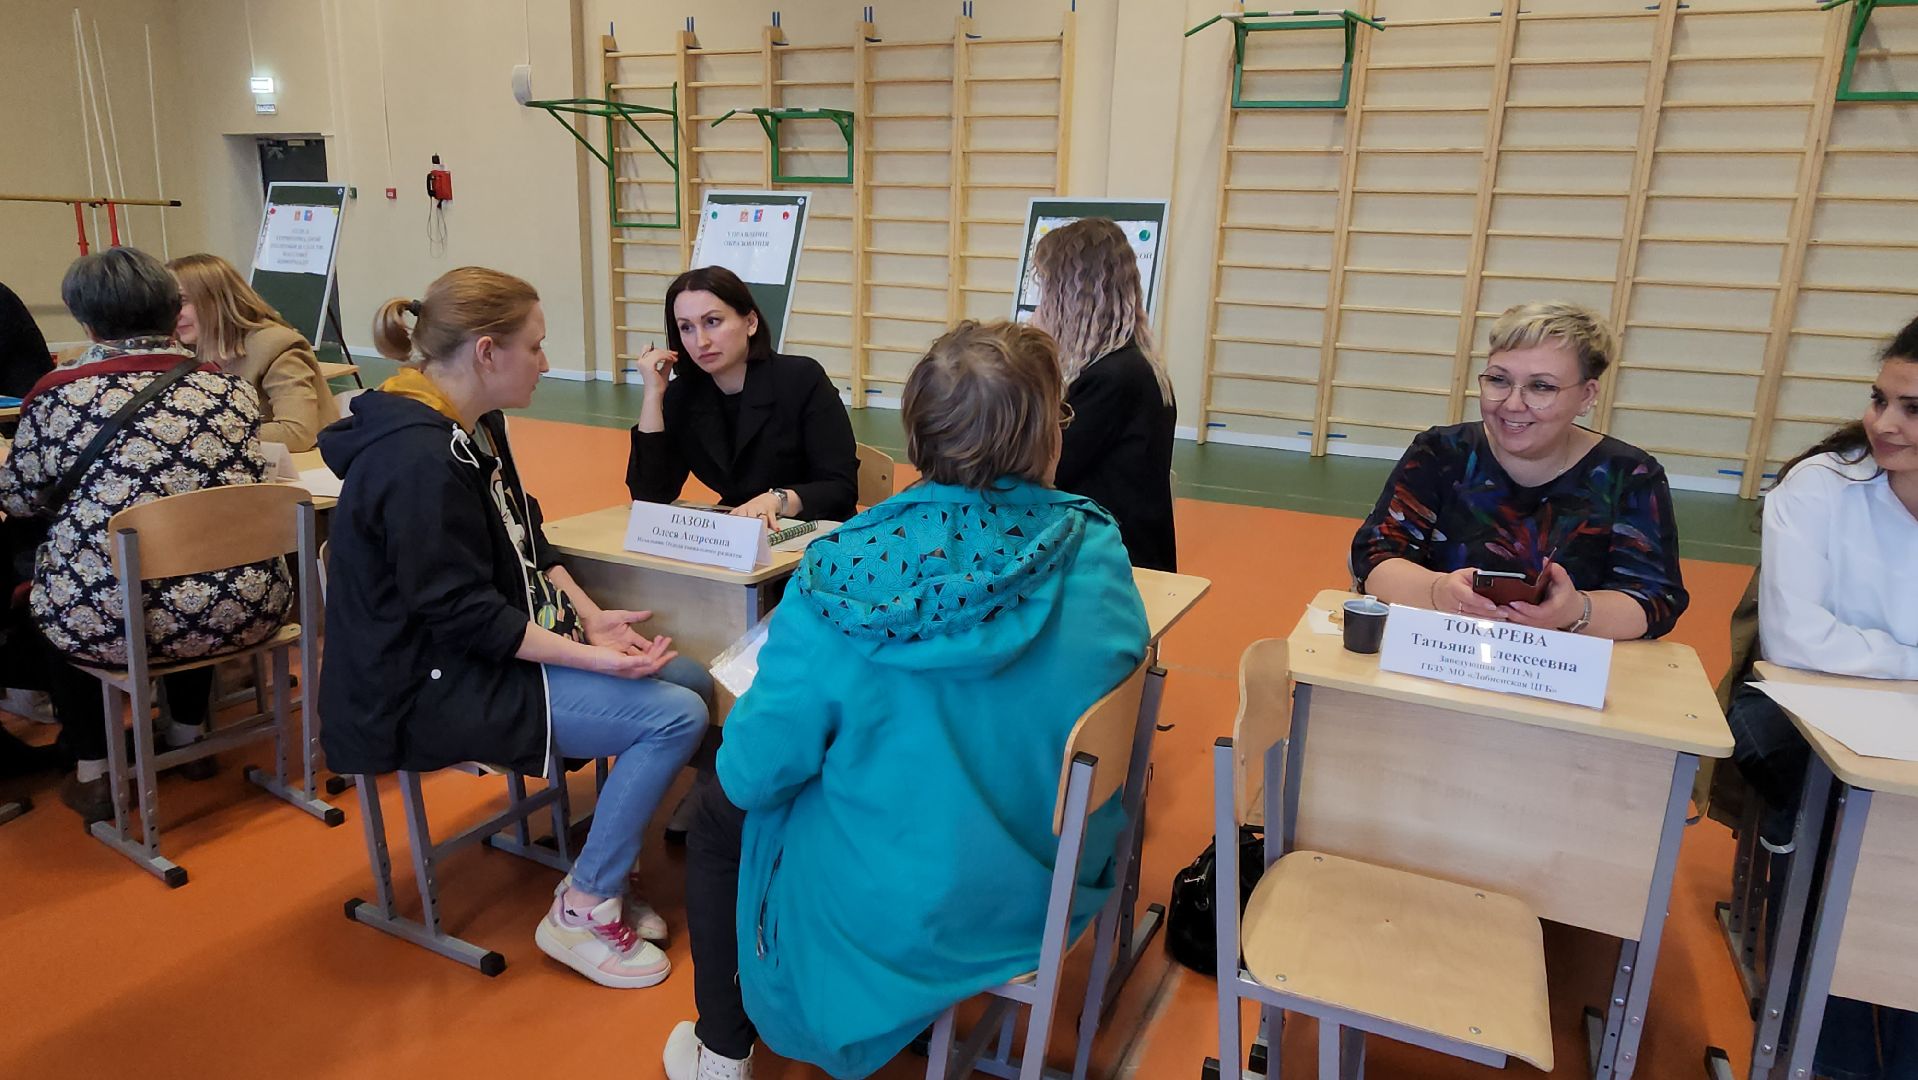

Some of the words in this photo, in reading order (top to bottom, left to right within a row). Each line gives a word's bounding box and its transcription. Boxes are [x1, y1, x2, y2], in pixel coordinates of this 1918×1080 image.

[671, 513, 718, 530] ПАЗОВА
[652, 526, 679, 539] Олеся
[681, 531, 730, 548] Андреевна
[1444, 618, 1548, 648] ТОКАРЕВА
[1411, 632, 1476, 655] Татьяна
[1482, 643, 1577, 673] лексеевна
[1449, 668, 1466, 677] МО
